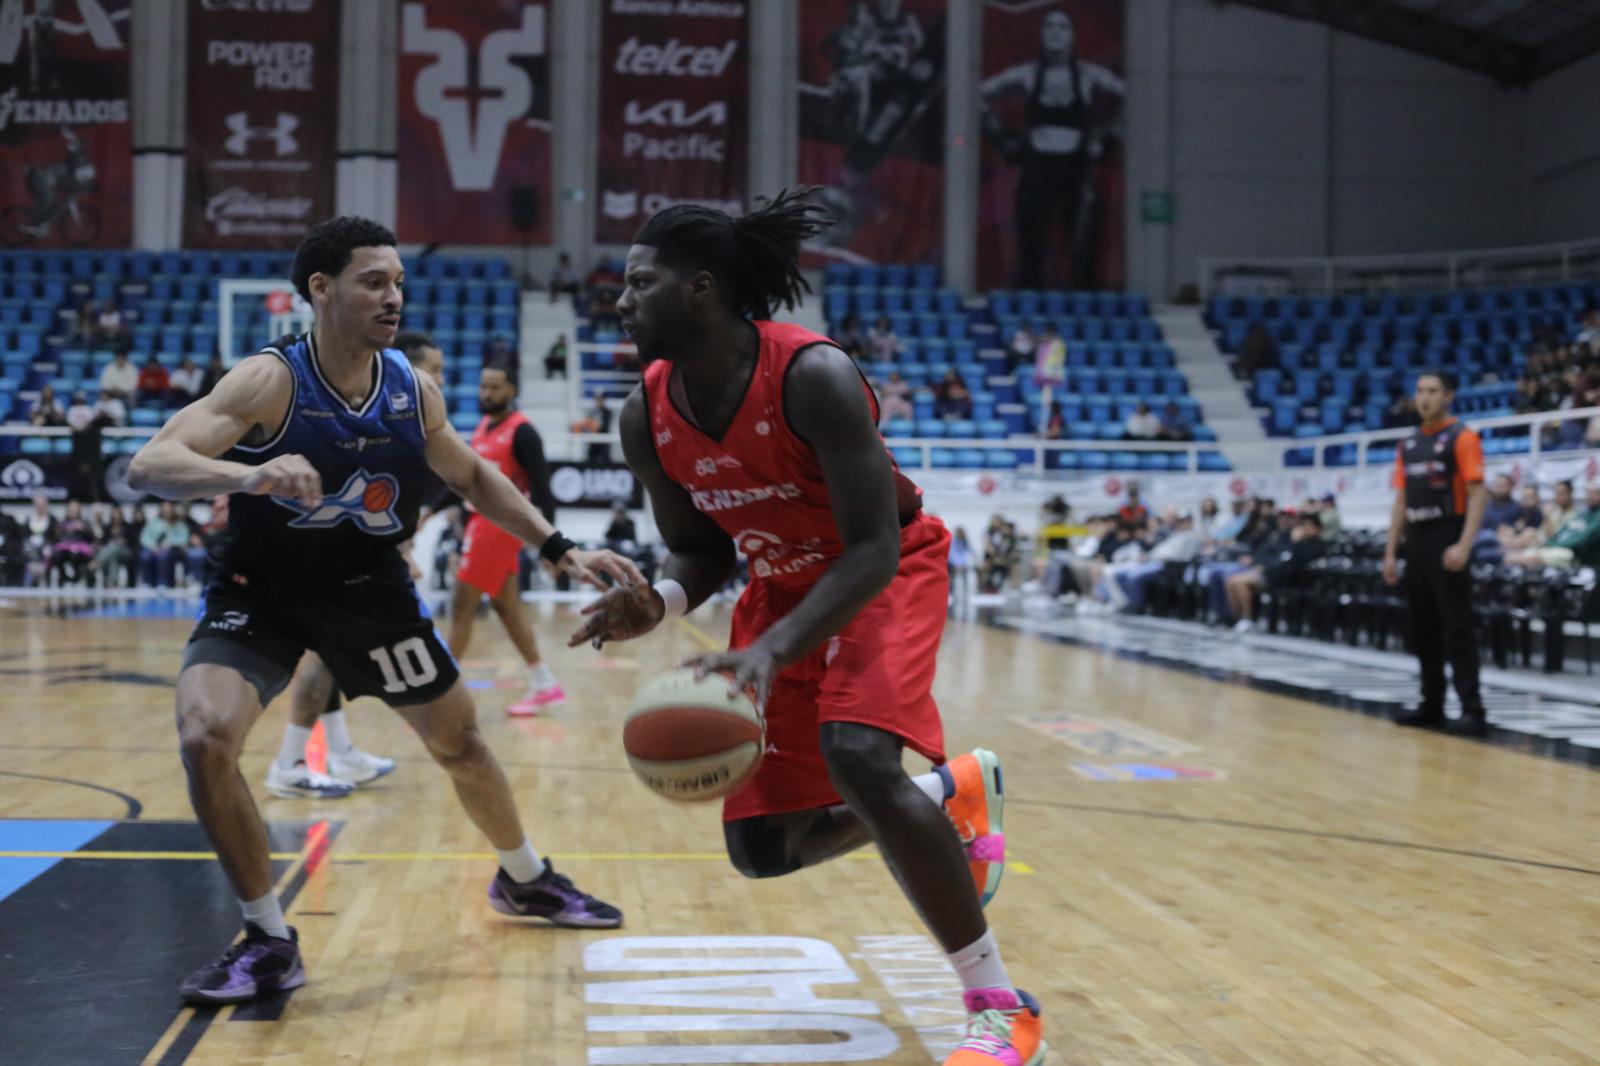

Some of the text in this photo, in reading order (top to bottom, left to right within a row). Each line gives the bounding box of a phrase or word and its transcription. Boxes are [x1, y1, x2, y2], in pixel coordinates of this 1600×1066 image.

[207, 41, 314, 66] POWER
[614, 36, 737, 77] telcel
[623, 131, 726, 161] Pacific
[369, 636, 438, 694] 10
[583, 935, 899, 1065] UAD
